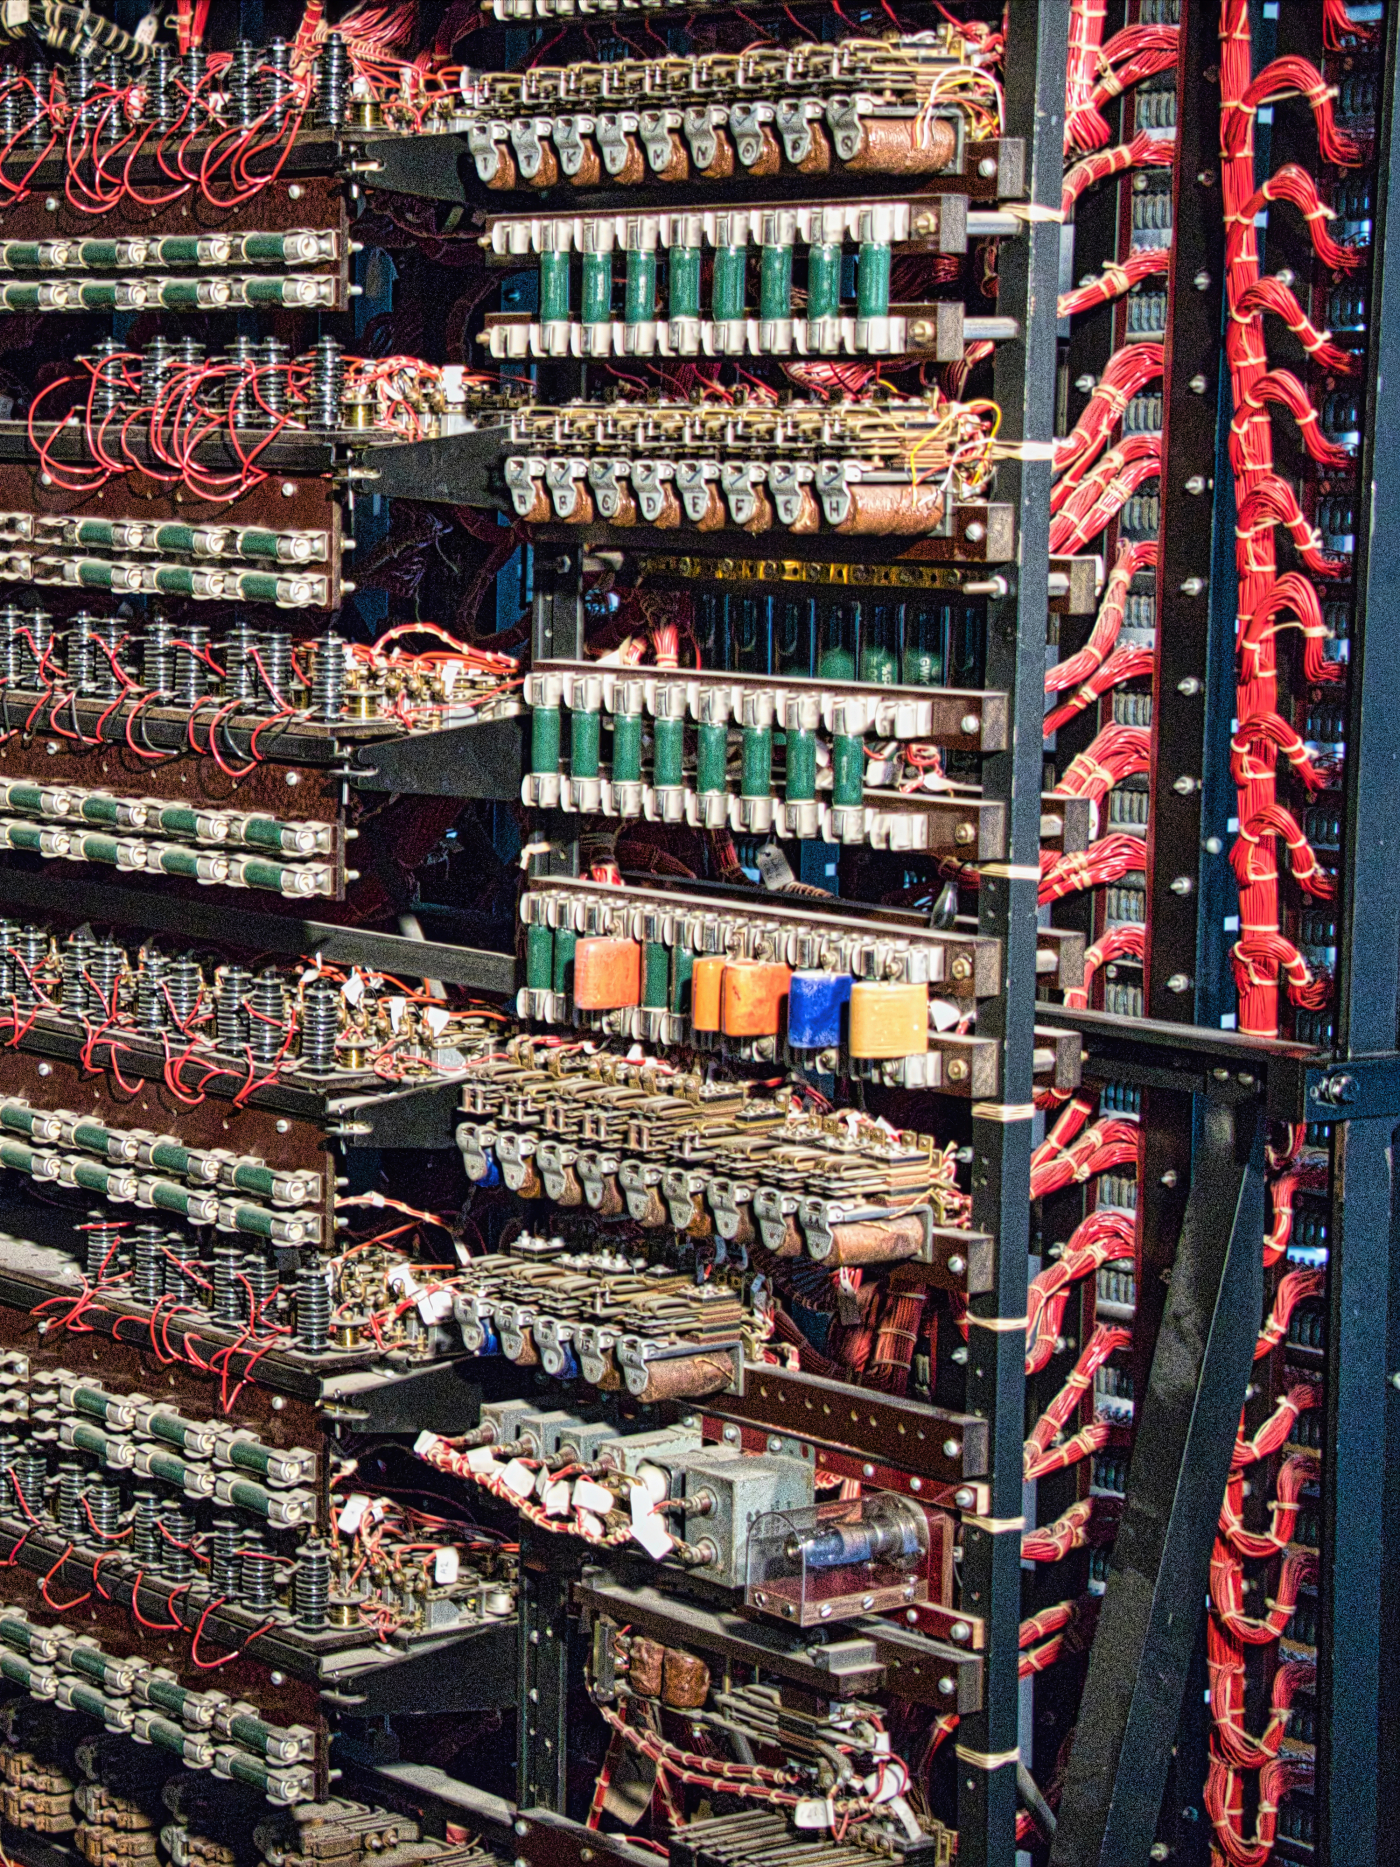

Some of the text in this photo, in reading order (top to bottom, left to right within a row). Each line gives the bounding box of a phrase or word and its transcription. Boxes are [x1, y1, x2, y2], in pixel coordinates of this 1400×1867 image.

[653, 149, 665, 165] M
[696, 145, 707, 161] N
[517, 493, 527, 509] A
[601, 493, 611, 511] C
[646, 497, 656, 513] D
[692, 496, 700, 514] E
[735, 498, 744, 517] F
[829, 501, 840, 518] H
